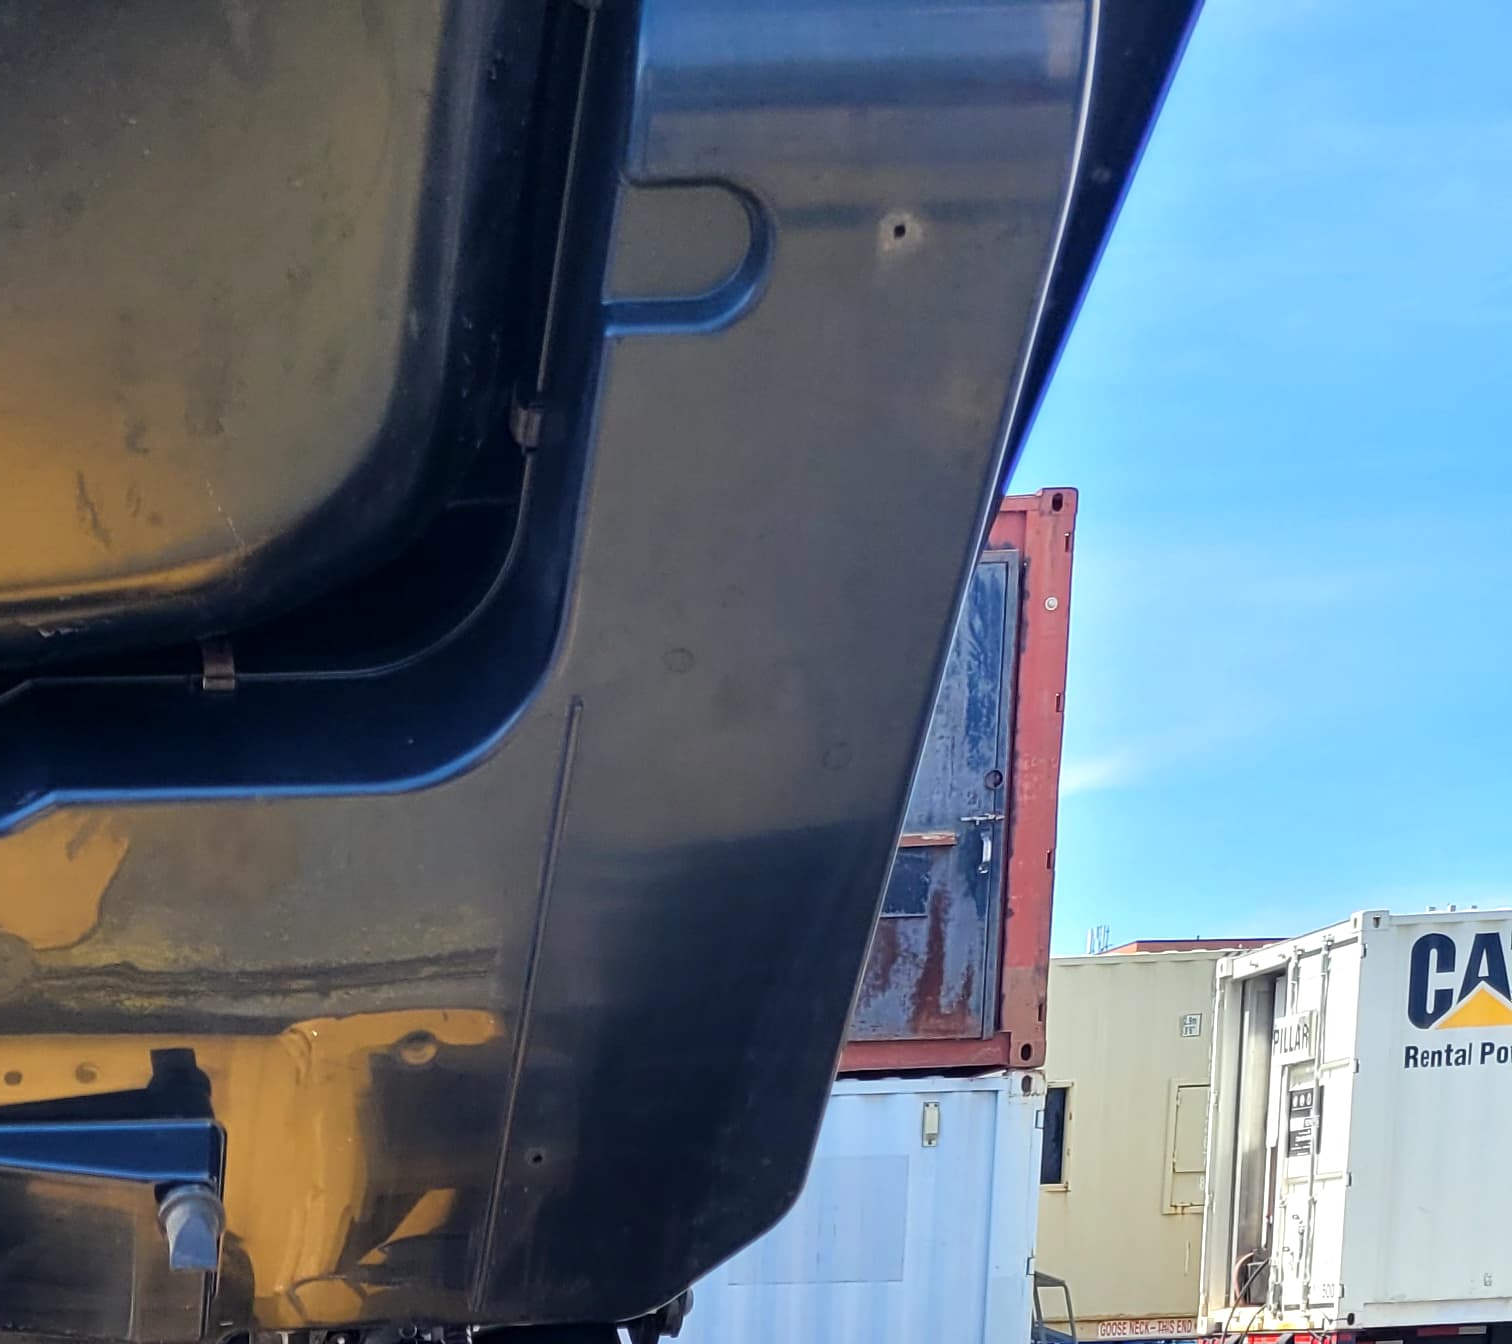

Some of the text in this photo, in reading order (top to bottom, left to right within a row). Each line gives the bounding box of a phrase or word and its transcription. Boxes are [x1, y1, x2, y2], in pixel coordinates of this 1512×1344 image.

[1408, 932, 1512, 1030] CA
[1403, 1041, 1512, 1068] Rental Po
[1099, 1321, 1128, 1337] GOOSE
[1176, 1319, 1193, 1334] END
